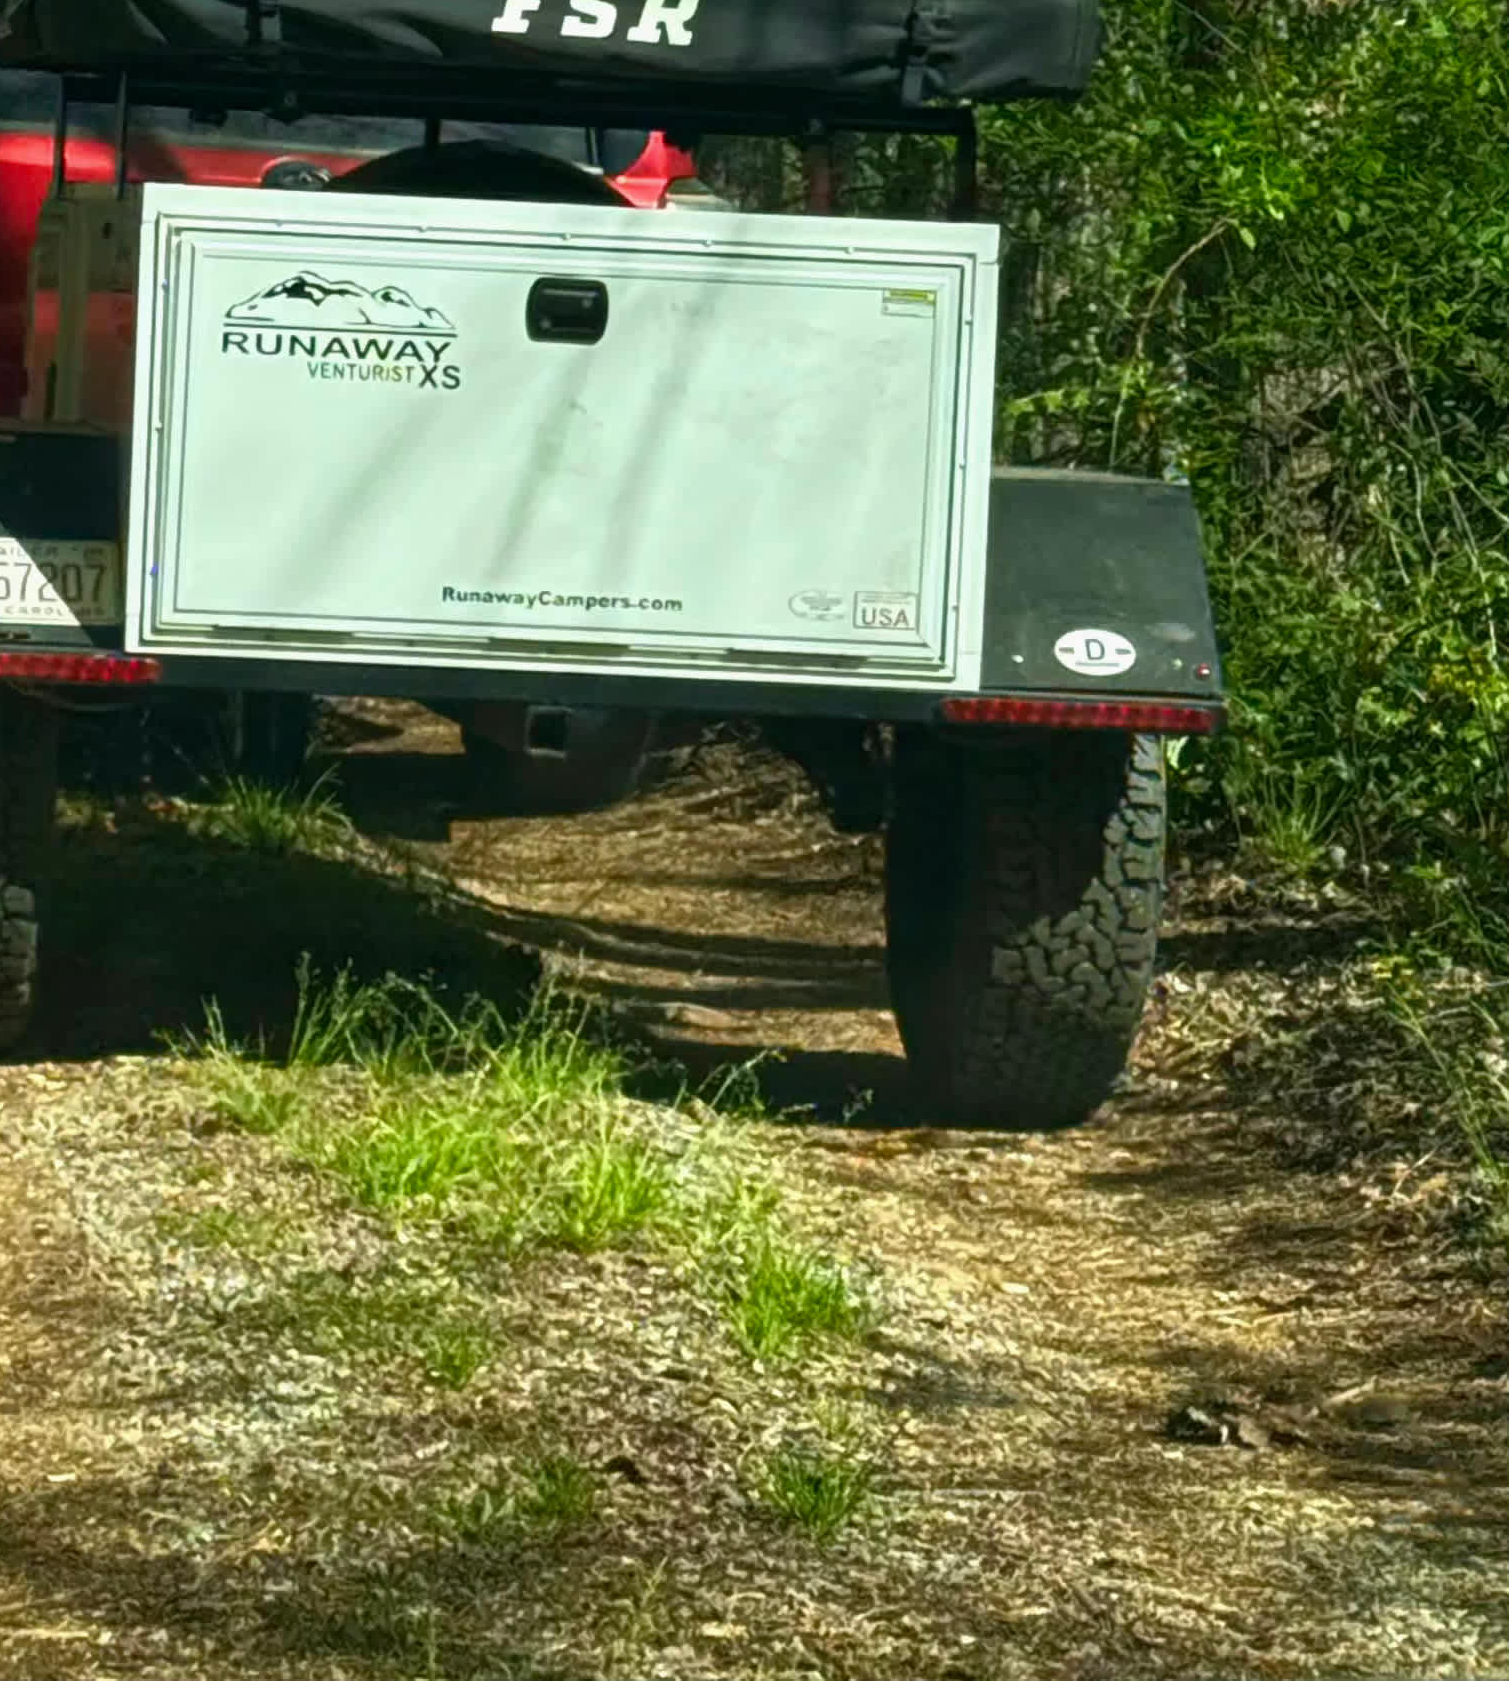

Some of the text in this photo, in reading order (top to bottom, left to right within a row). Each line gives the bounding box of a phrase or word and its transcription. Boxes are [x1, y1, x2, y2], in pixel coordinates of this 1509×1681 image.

[221, 331, 452, 364] RUNAWAY
[307, 360, 462, 390] VENTURIST XS
[441, 586, 684, 611] RunawayCampers.com
[4, 604, 106, 618] CAROLNA
[861, 606, 910, 628] USA
[1084, 638, 1106, 661] D
